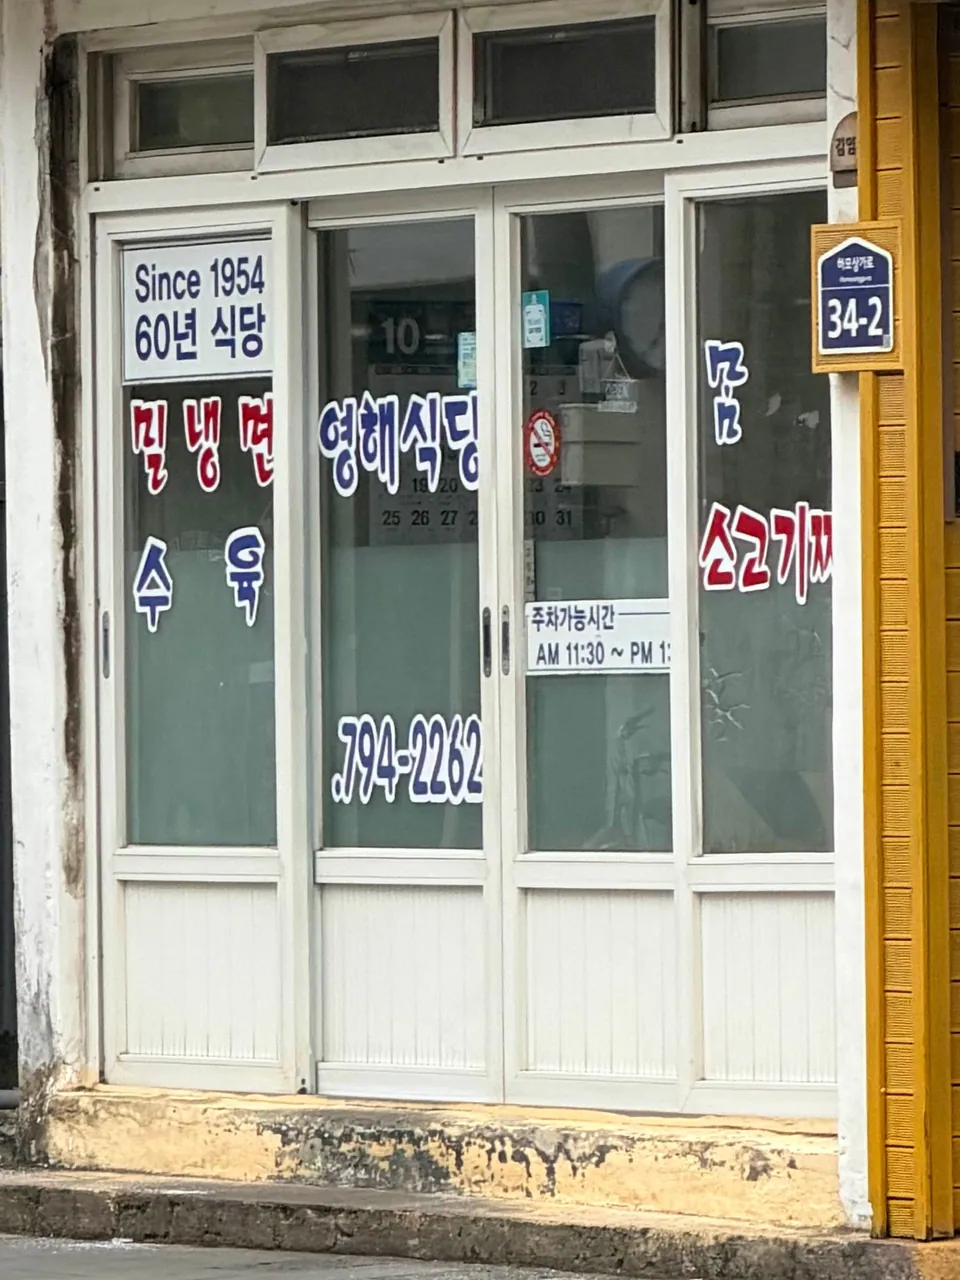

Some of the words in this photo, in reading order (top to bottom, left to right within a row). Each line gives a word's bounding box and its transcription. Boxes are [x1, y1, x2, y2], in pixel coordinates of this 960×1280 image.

[135, 264, 200, 302] Since
[210, 255, 265, 297] 1954
[135, 307, 198, 361] 60년
[210, 303, 266, 360] 식당
[381, 317, 420, 354] 10
[827, 296, 883, 339] 34-2
[319, 390, 480, 497] 영해식당
[382, 510, 401, 526] 25
[411, 510, 430, 526] 26
[532, 604, 615, 632] 주차가능시간
[536, 642, 559, 666] AM
[566, 641, 605, 666] 11:30
[630, 641, 653, 664] PM
